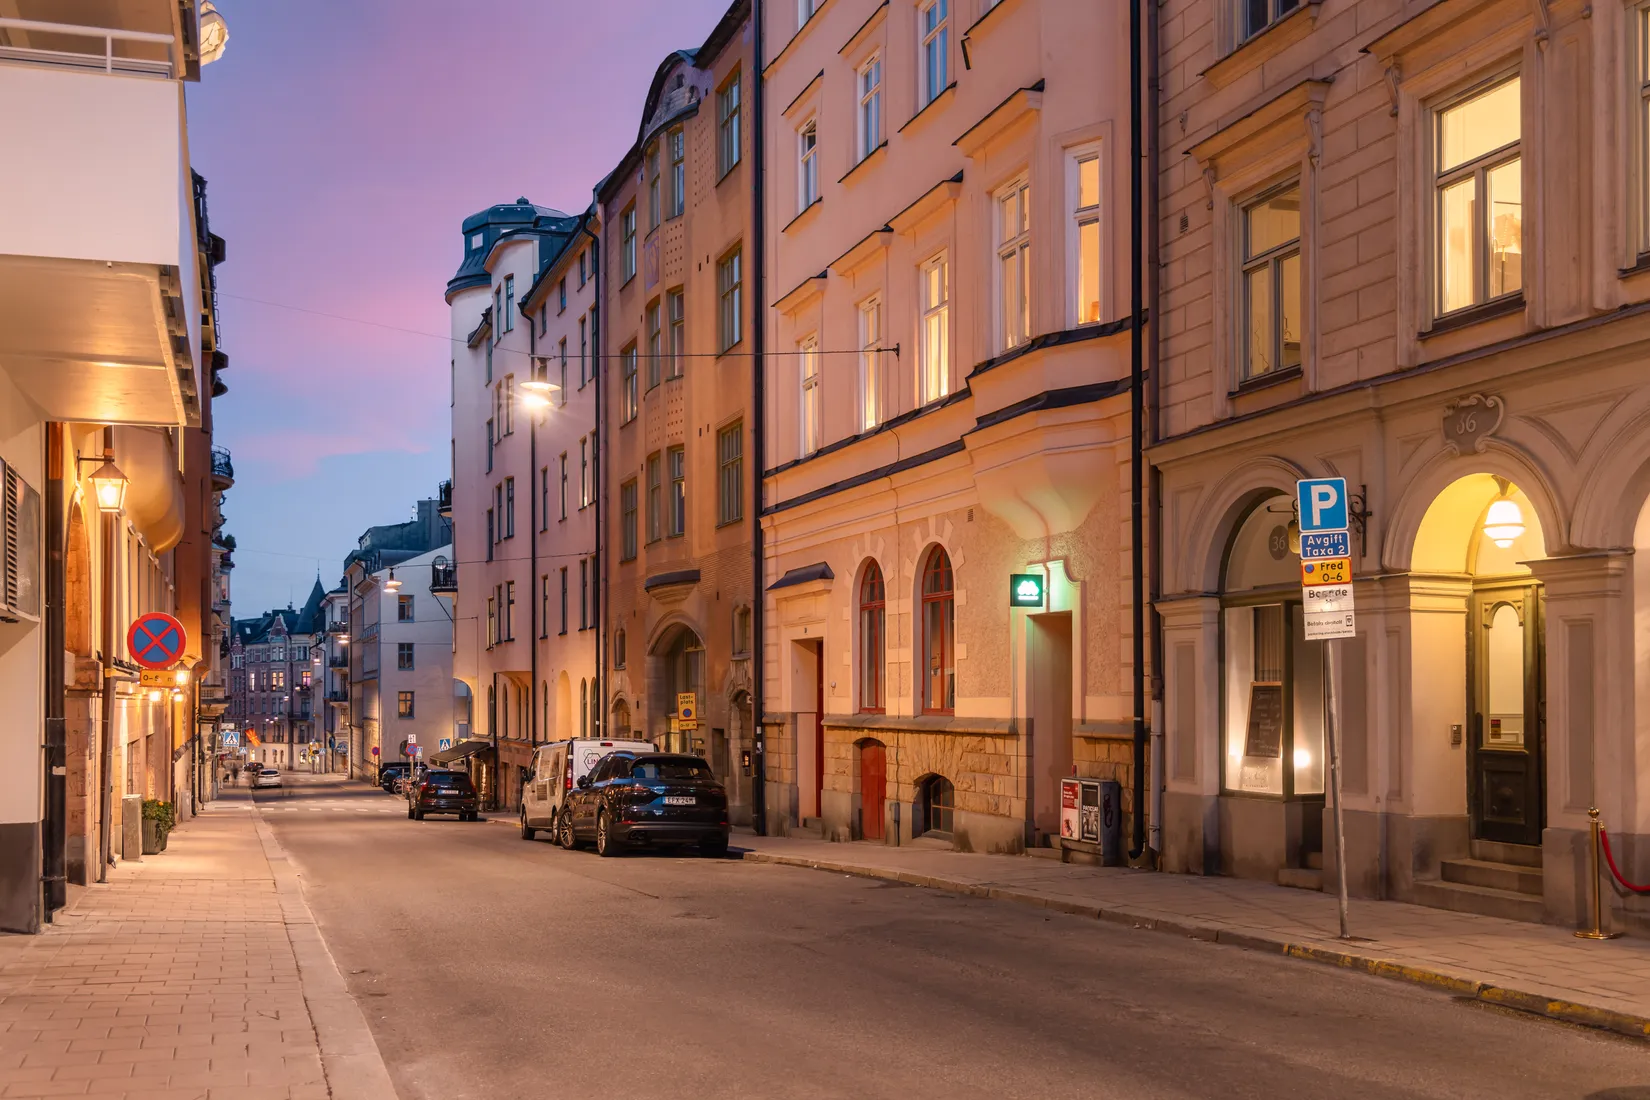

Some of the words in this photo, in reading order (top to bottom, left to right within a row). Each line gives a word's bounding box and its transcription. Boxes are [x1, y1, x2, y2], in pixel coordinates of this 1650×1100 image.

[1310, 484, 1338, 526] P
[1271, 534, 1286, 551] 36
[1307, 534, 1343, 546] Avgift
[1305, 547, 1334, 556] Taxa
[1338, 545, 1345, 554] 2
[1320, 561, 1344, 571] Fred
[1322, 572, 1343, 582] 0-6
